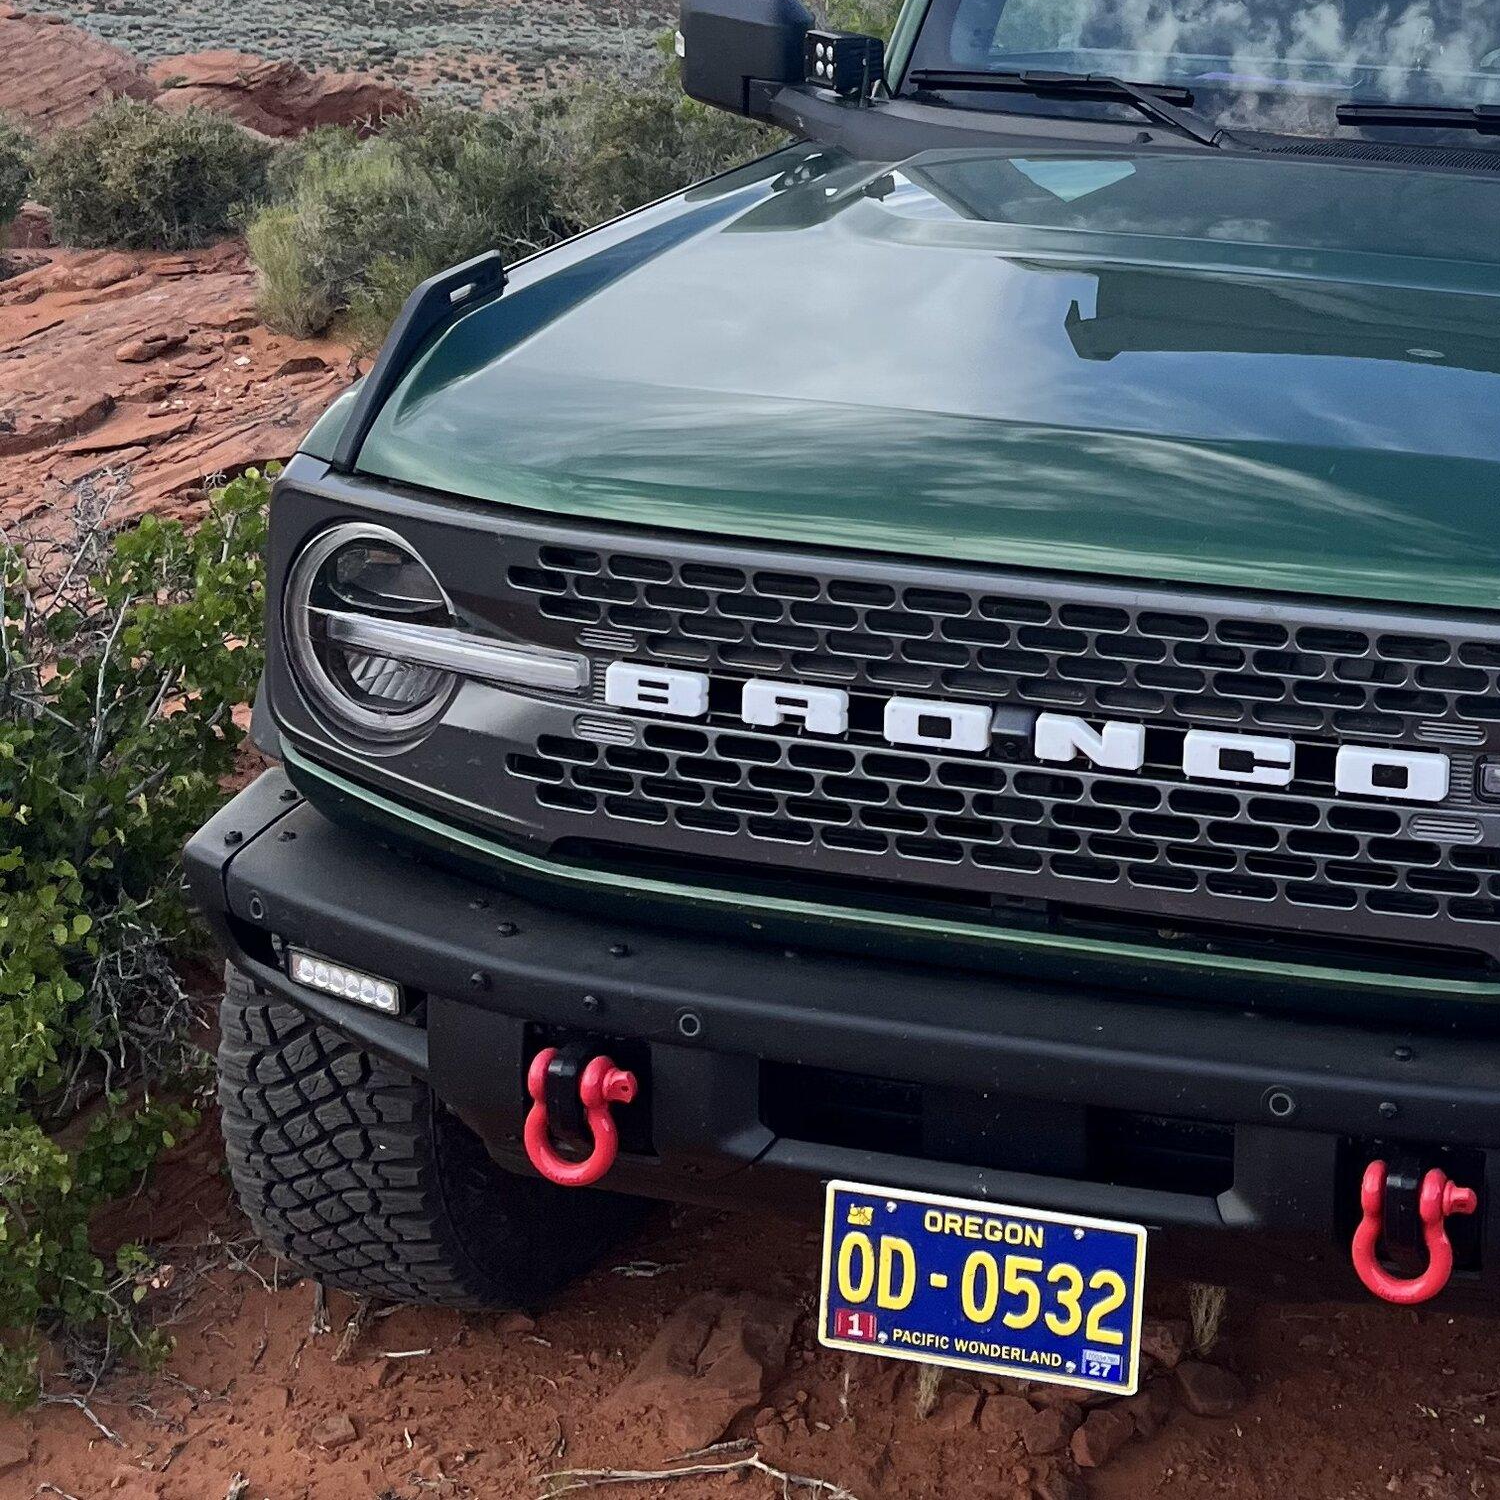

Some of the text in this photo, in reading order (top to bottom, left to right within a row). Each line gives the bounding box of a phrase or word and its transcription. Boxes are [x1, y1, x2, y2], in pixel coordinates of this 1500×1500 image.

[605, 661, 1450, 802] BRONCO
[924, 1210, 1044, 1248] OREGON
[847, 1313, 863, 1337] 1
[892, 1328, 950, 1350] PACIFIC
[954, 1339, 1063, 1368] WONDERLAND
[1089, 1361, 1111, 1377] 27
